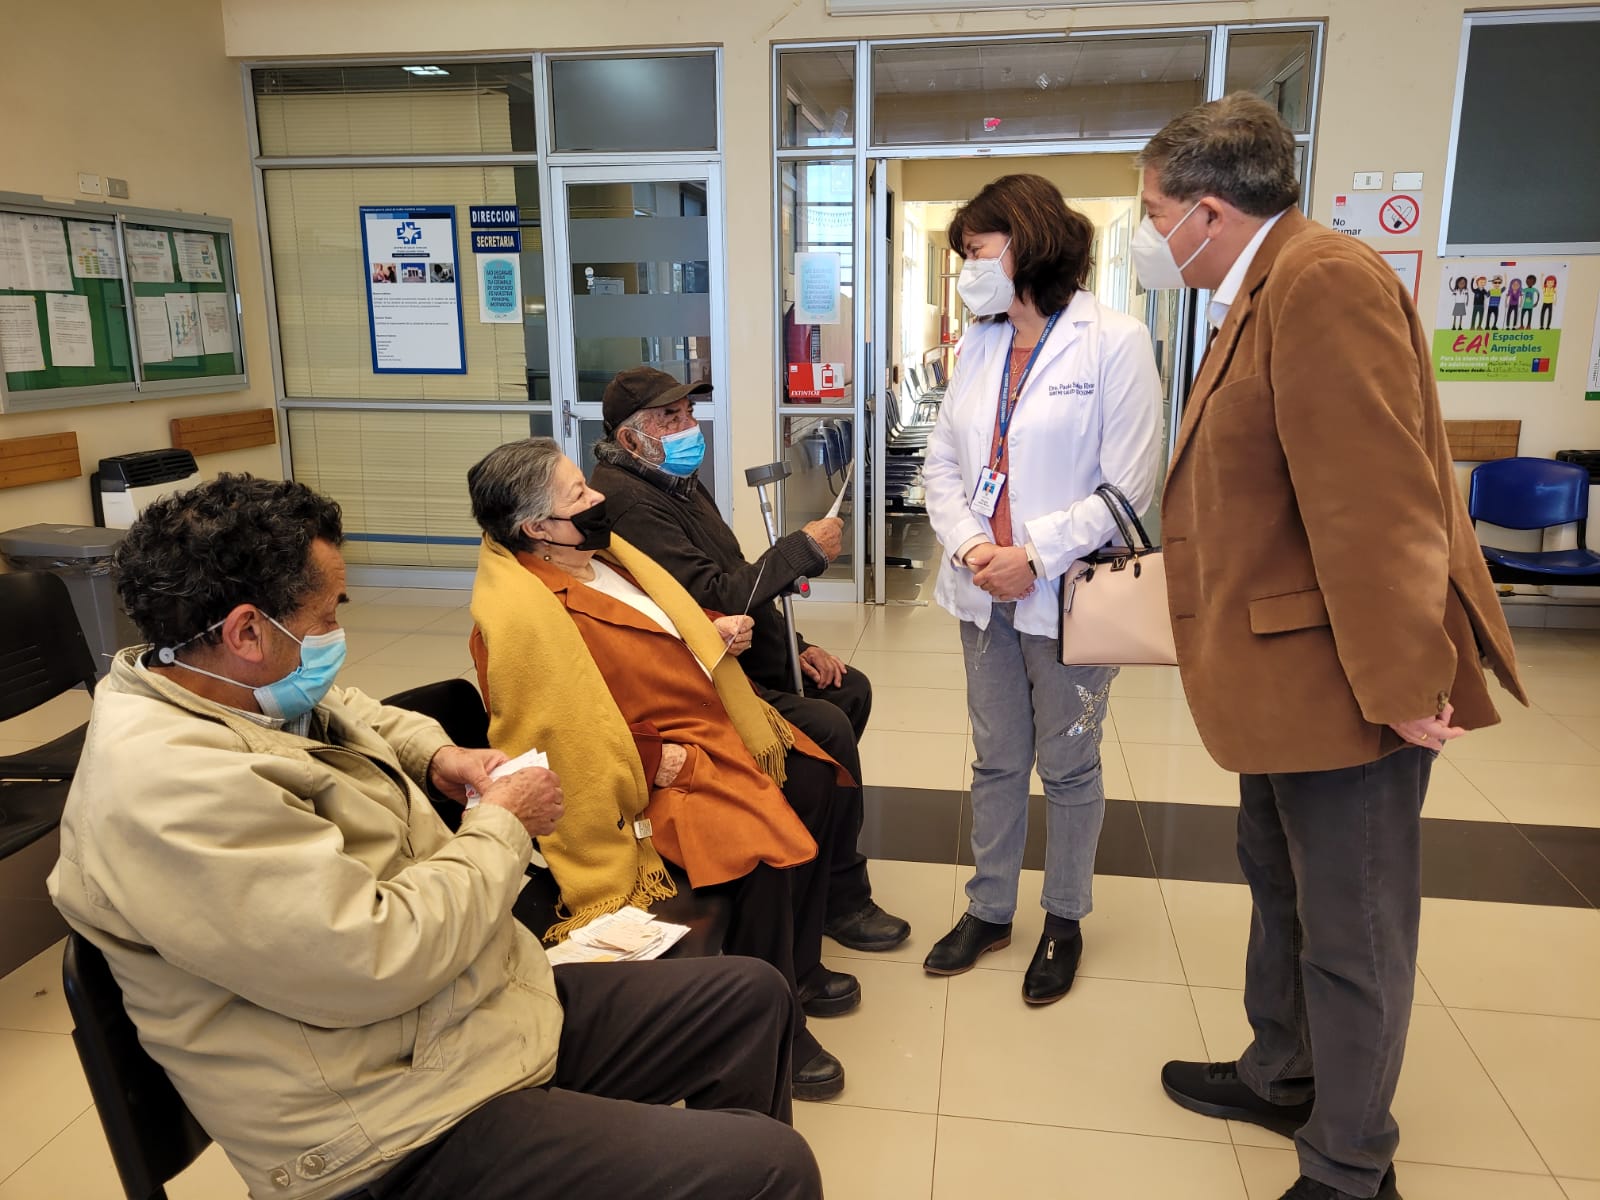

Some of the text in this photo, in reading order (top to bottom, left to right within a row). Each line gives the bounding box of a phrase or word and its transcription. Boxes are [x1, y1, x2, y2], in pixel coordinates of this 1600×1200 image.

[471, 210, 516, 223] DIRECCION
[1332, 218, 1346, 226] No
[1332, 228, 1362, 236] umar
[476, 235, 515, 248] SECRETARIA
[1493, 332, 1534, 342] Espacios
[1452, 332, 1489, 354] EA!
[1491, 344, 1541, 354] Amigables
